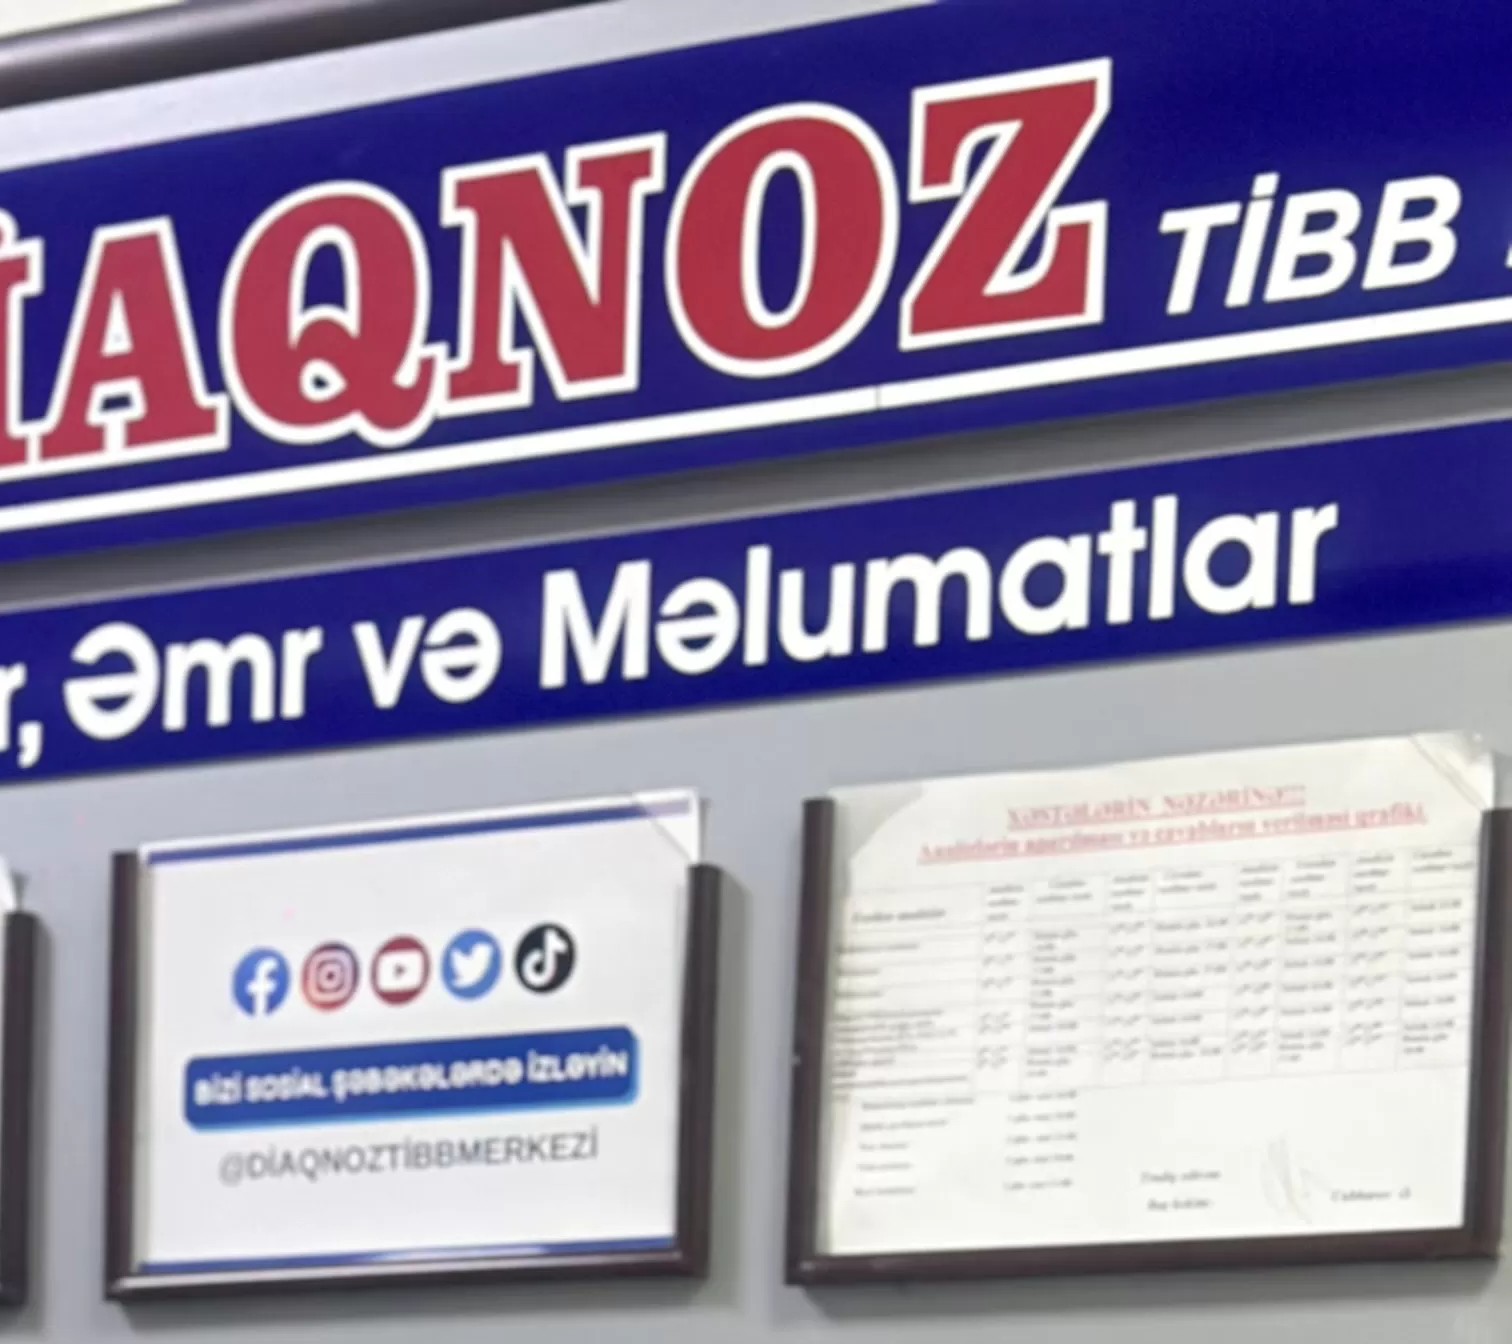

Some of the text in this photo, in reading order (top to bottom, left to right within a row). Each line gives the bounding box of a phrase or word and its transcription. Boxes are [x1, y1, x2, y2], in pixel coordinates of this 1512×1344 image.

[1157, 172, 1462, 315] TİBB
[63, 621, 324, 741] Əmr
[353, 606, 503, 710] və
[539, 494, 1338, 689] Məlumatlar
